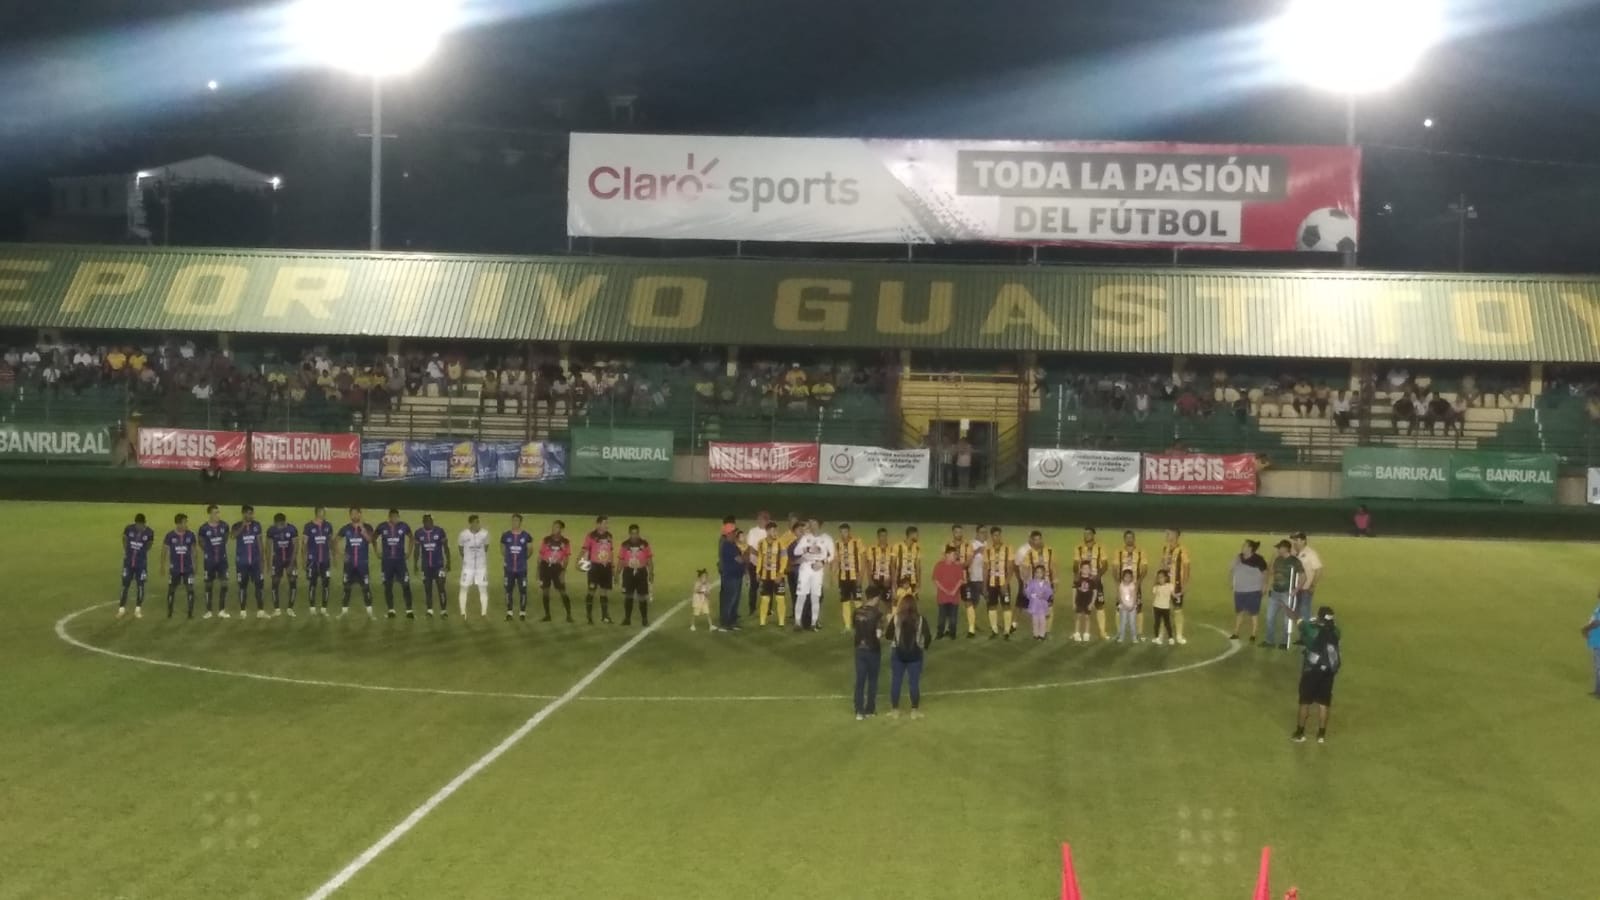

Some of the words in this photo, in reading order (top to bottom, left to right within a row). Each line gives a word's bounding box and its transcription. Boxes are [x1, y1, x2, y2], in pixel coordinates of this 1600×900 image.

[588, 162, 704, 201] Claro
[728, 171, 860, 212] sports
[973, 160, 1072, 190] TODA
[1081, 162, 1127, 190] LA
[1135, 157, 1269, 193] PASIÓN
[1014, 206, 1080, 233] DEL
[1089, 201, 1227, 237] FÚTBOL
[140, 430, 216, 457] REDESIS
[254, 437, 332, 461] RETELECOM
[602, 446, 670, 461] BANRURAL
[1145, 457, 1224, 481] REDESIS
[1375, 466, 1446, 481] BANRURAL
[1486, 468, 1553, 483] BANRURAL
